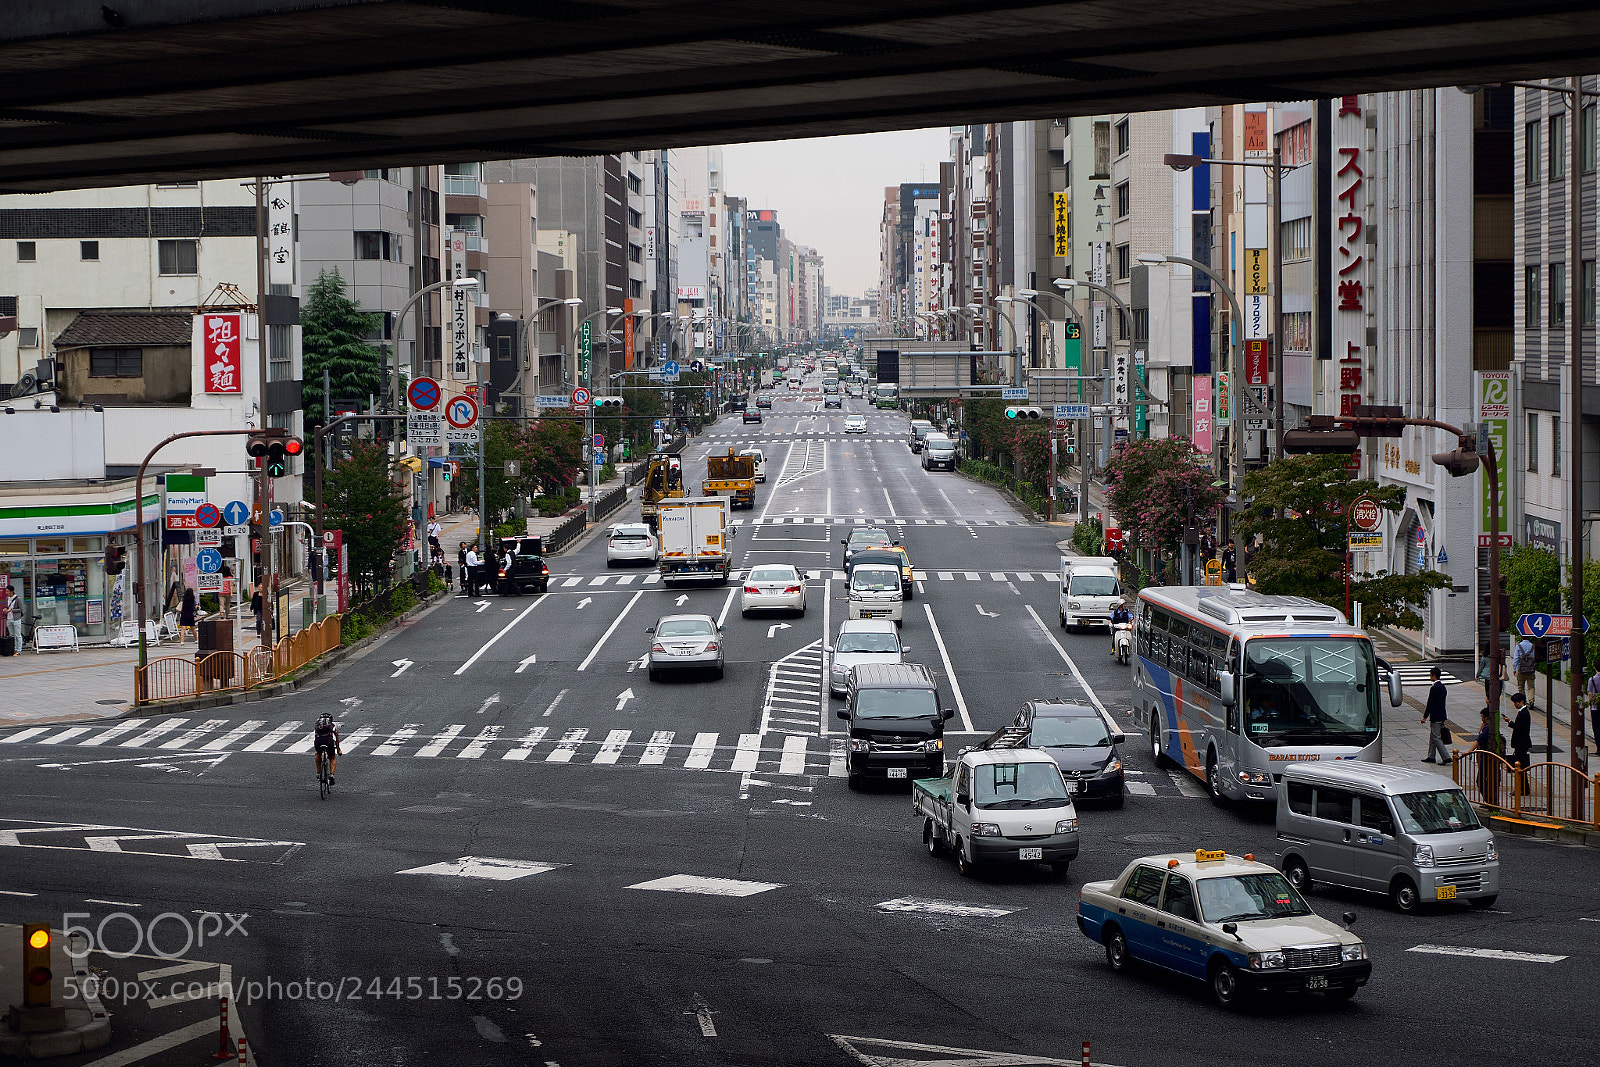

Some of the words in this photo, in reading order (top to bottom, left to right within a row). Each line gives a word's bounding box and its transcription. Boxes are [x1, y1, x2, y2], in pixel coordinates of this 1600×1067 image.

[1337, 147, 1363, 311] スイウン堂
[454, 290, 466, 373] 村上スッポン本舗
[208, 316, 237, 391] 担々麺
[1195, 398, 1210, 433] 白衣
[446, 432, 478, 440] ここから
[167, 497, 205, 506] FamilyMart
[1356, 508, 1377, 520] 消火栓
[1533, 616, 1544, 631] 4
